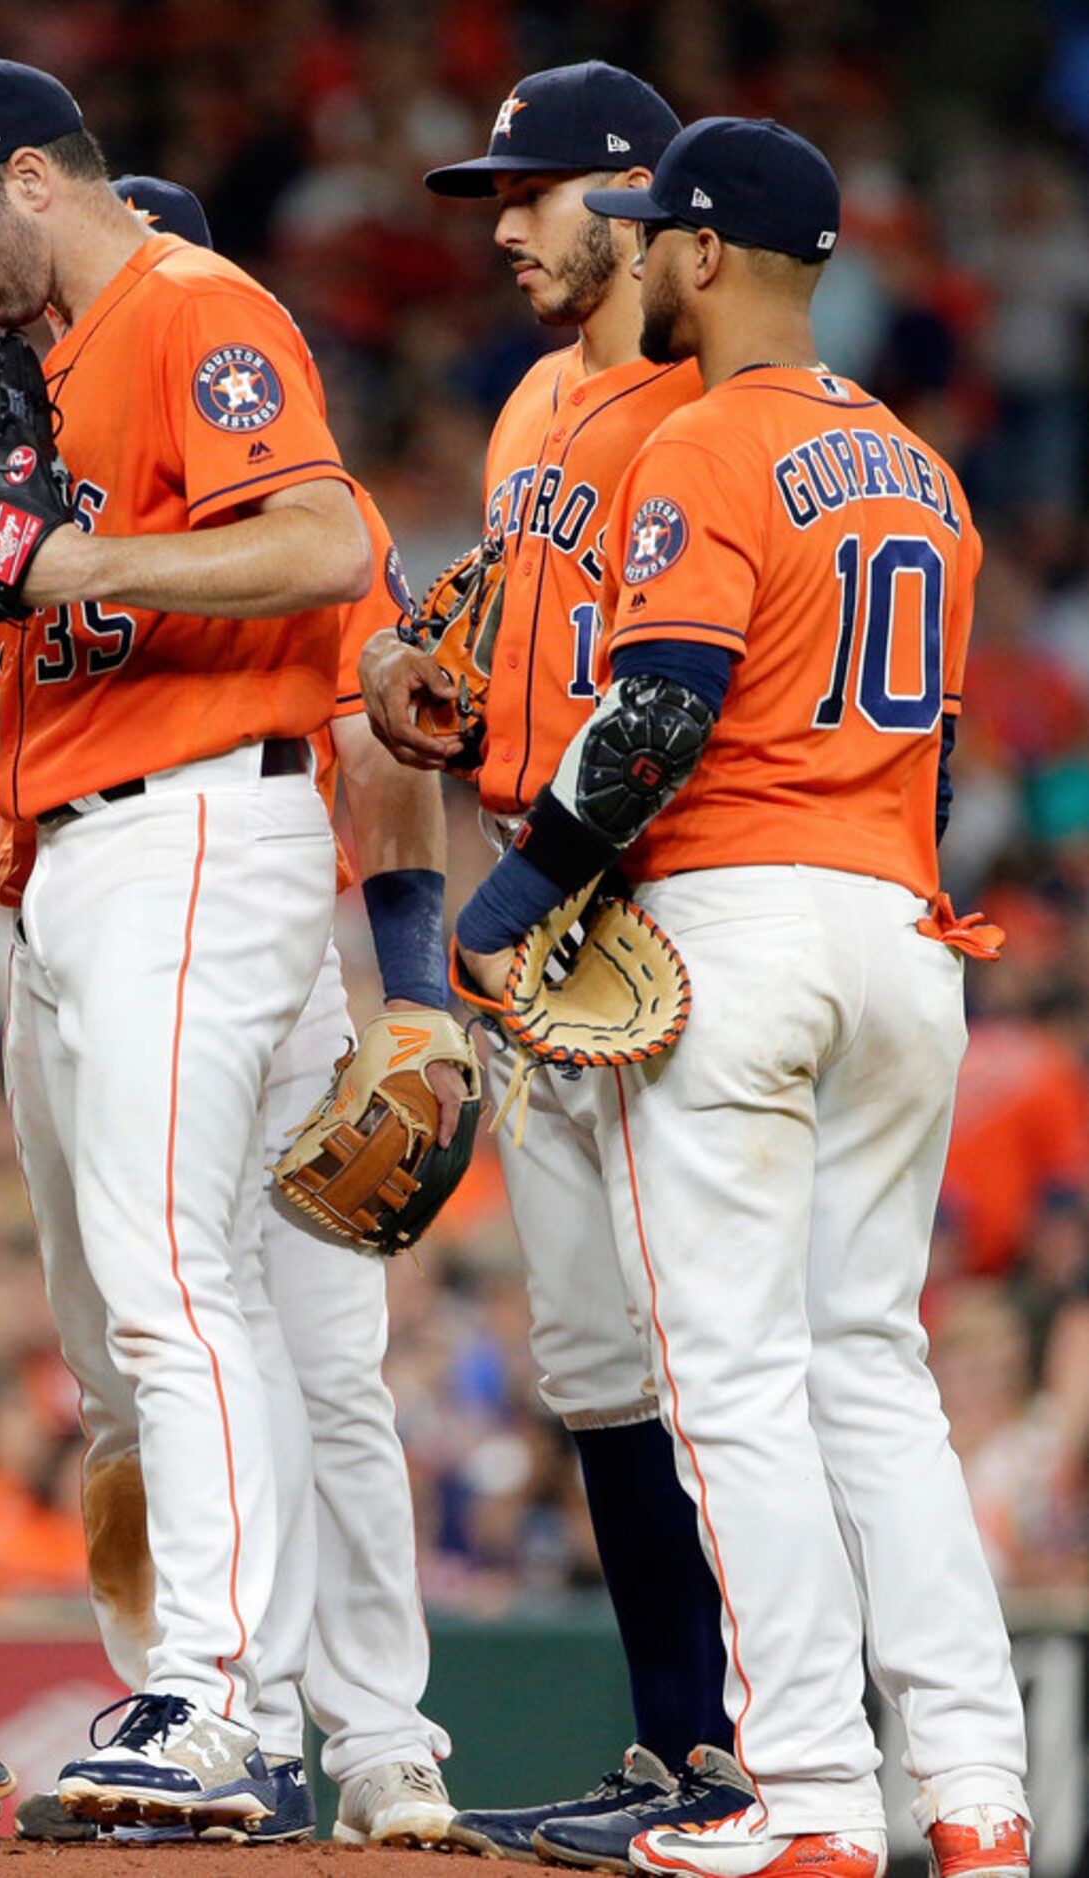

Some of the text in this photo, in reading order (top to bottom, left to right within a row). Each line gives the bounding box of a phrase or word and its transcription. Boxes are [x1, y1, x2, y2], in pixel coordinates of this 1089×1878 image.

[198, 348, 266, 384] HOUSTON
[218, 400, 278, 427] ASTROS
[774, 428, 961, 540] GURRIEL
[35, 600, 137, 685] 35
[810, 533, 945, 735] 10
